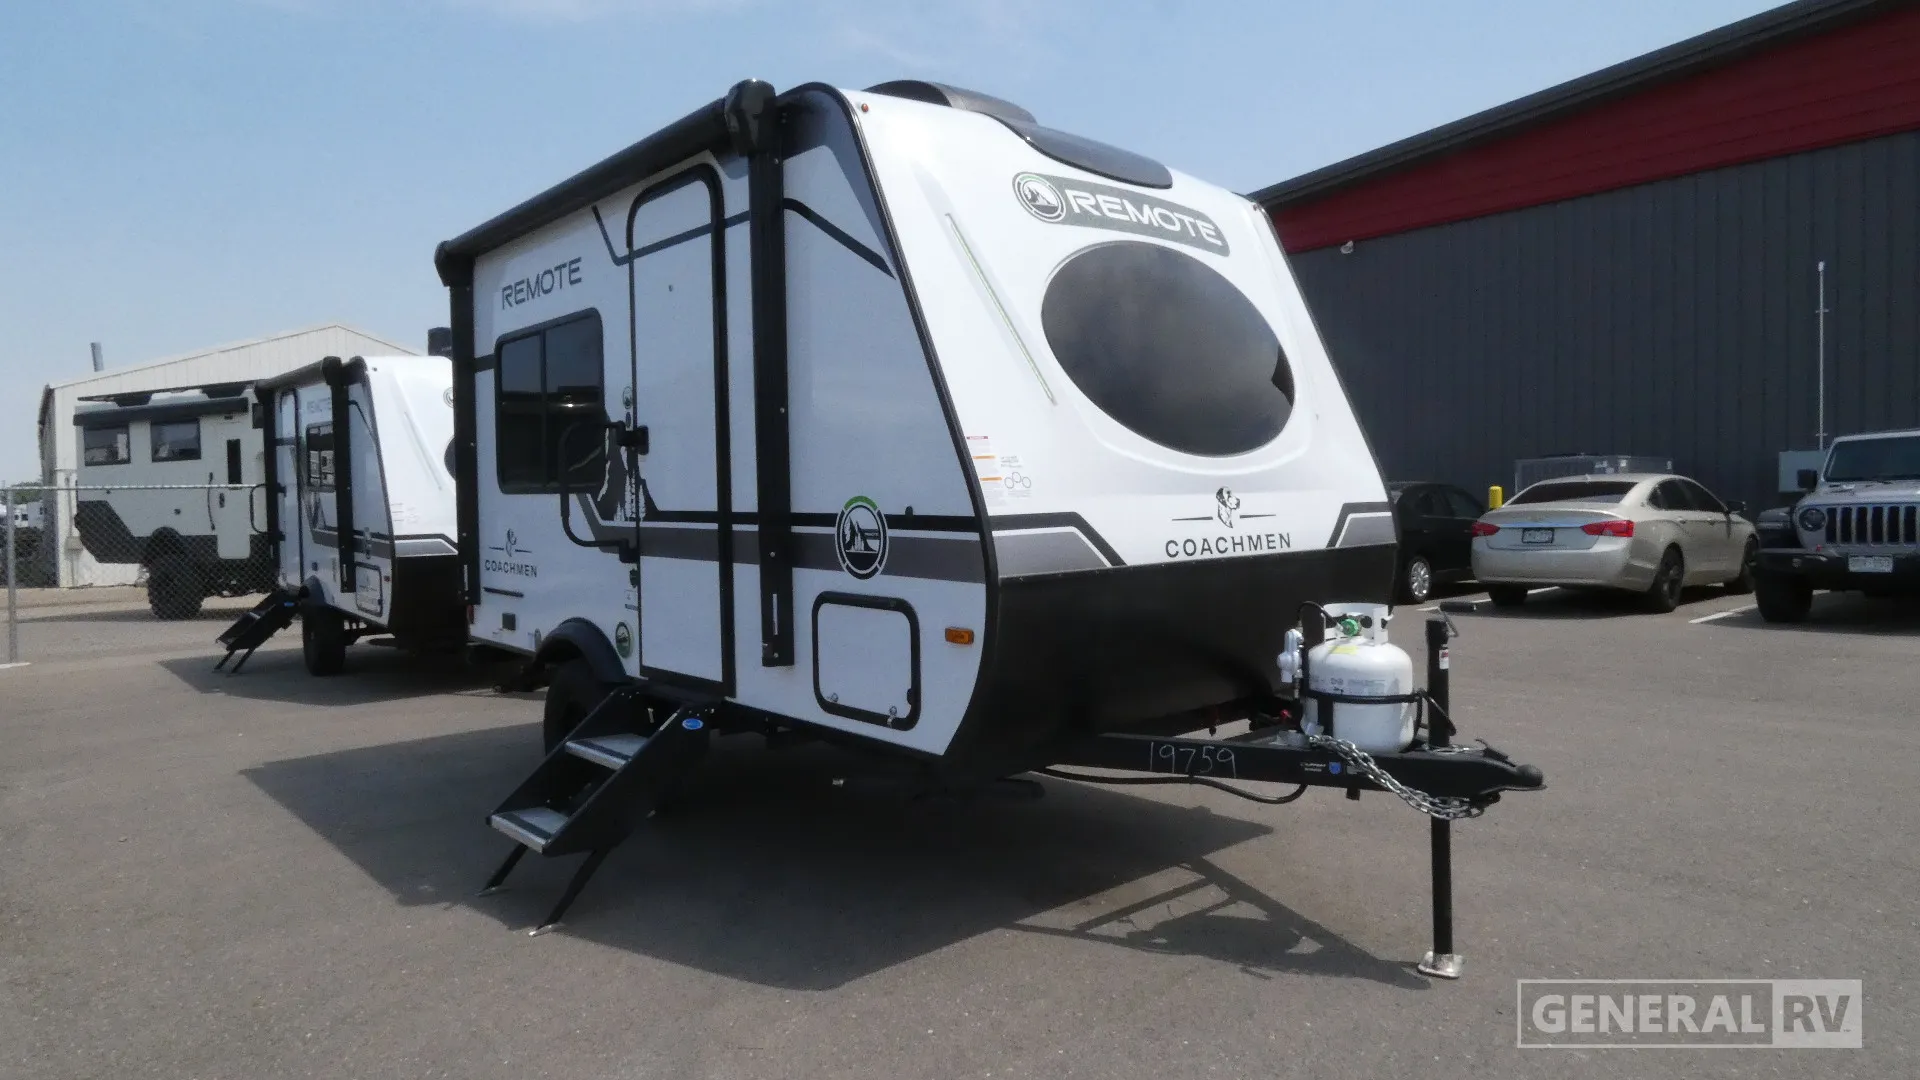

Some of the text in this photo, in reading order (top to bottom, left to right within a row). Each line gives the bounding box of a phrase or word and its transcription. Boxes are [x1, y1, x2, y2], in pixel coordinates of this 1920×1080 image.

[1064, 189, 1223, 246] REMOTE
[502, 257, 582, 310] REMOTE
[1165, 532, 1292, 558] COACHMEN
[484, 559, 538, 578] COACHMEN
[1149, 741, 1237, 778] 19759
